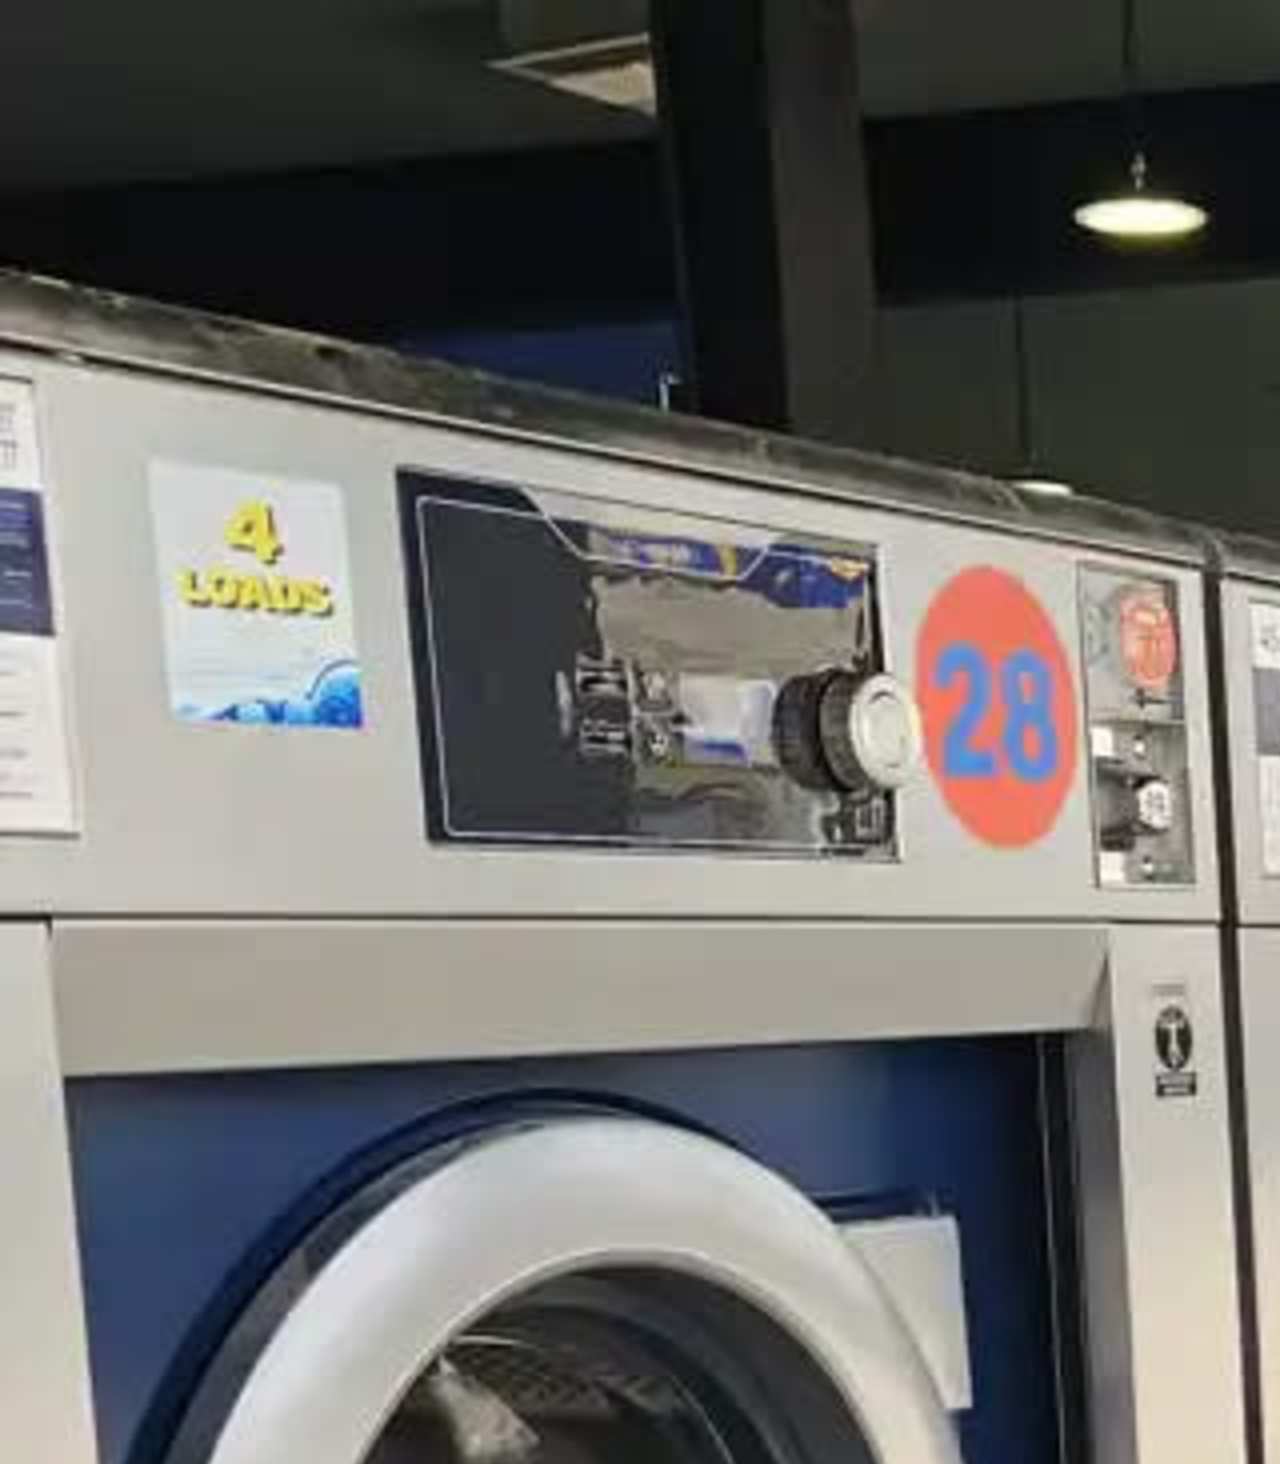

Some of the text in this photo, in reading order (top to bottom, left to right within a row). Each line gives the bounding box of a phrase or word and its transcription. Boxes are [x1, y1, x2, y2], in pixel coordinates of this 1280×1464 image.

[224, 498, 283, 566] 4
[175, 565, 333, 617] LOADS
[934, 640, 1057, 782] 28
